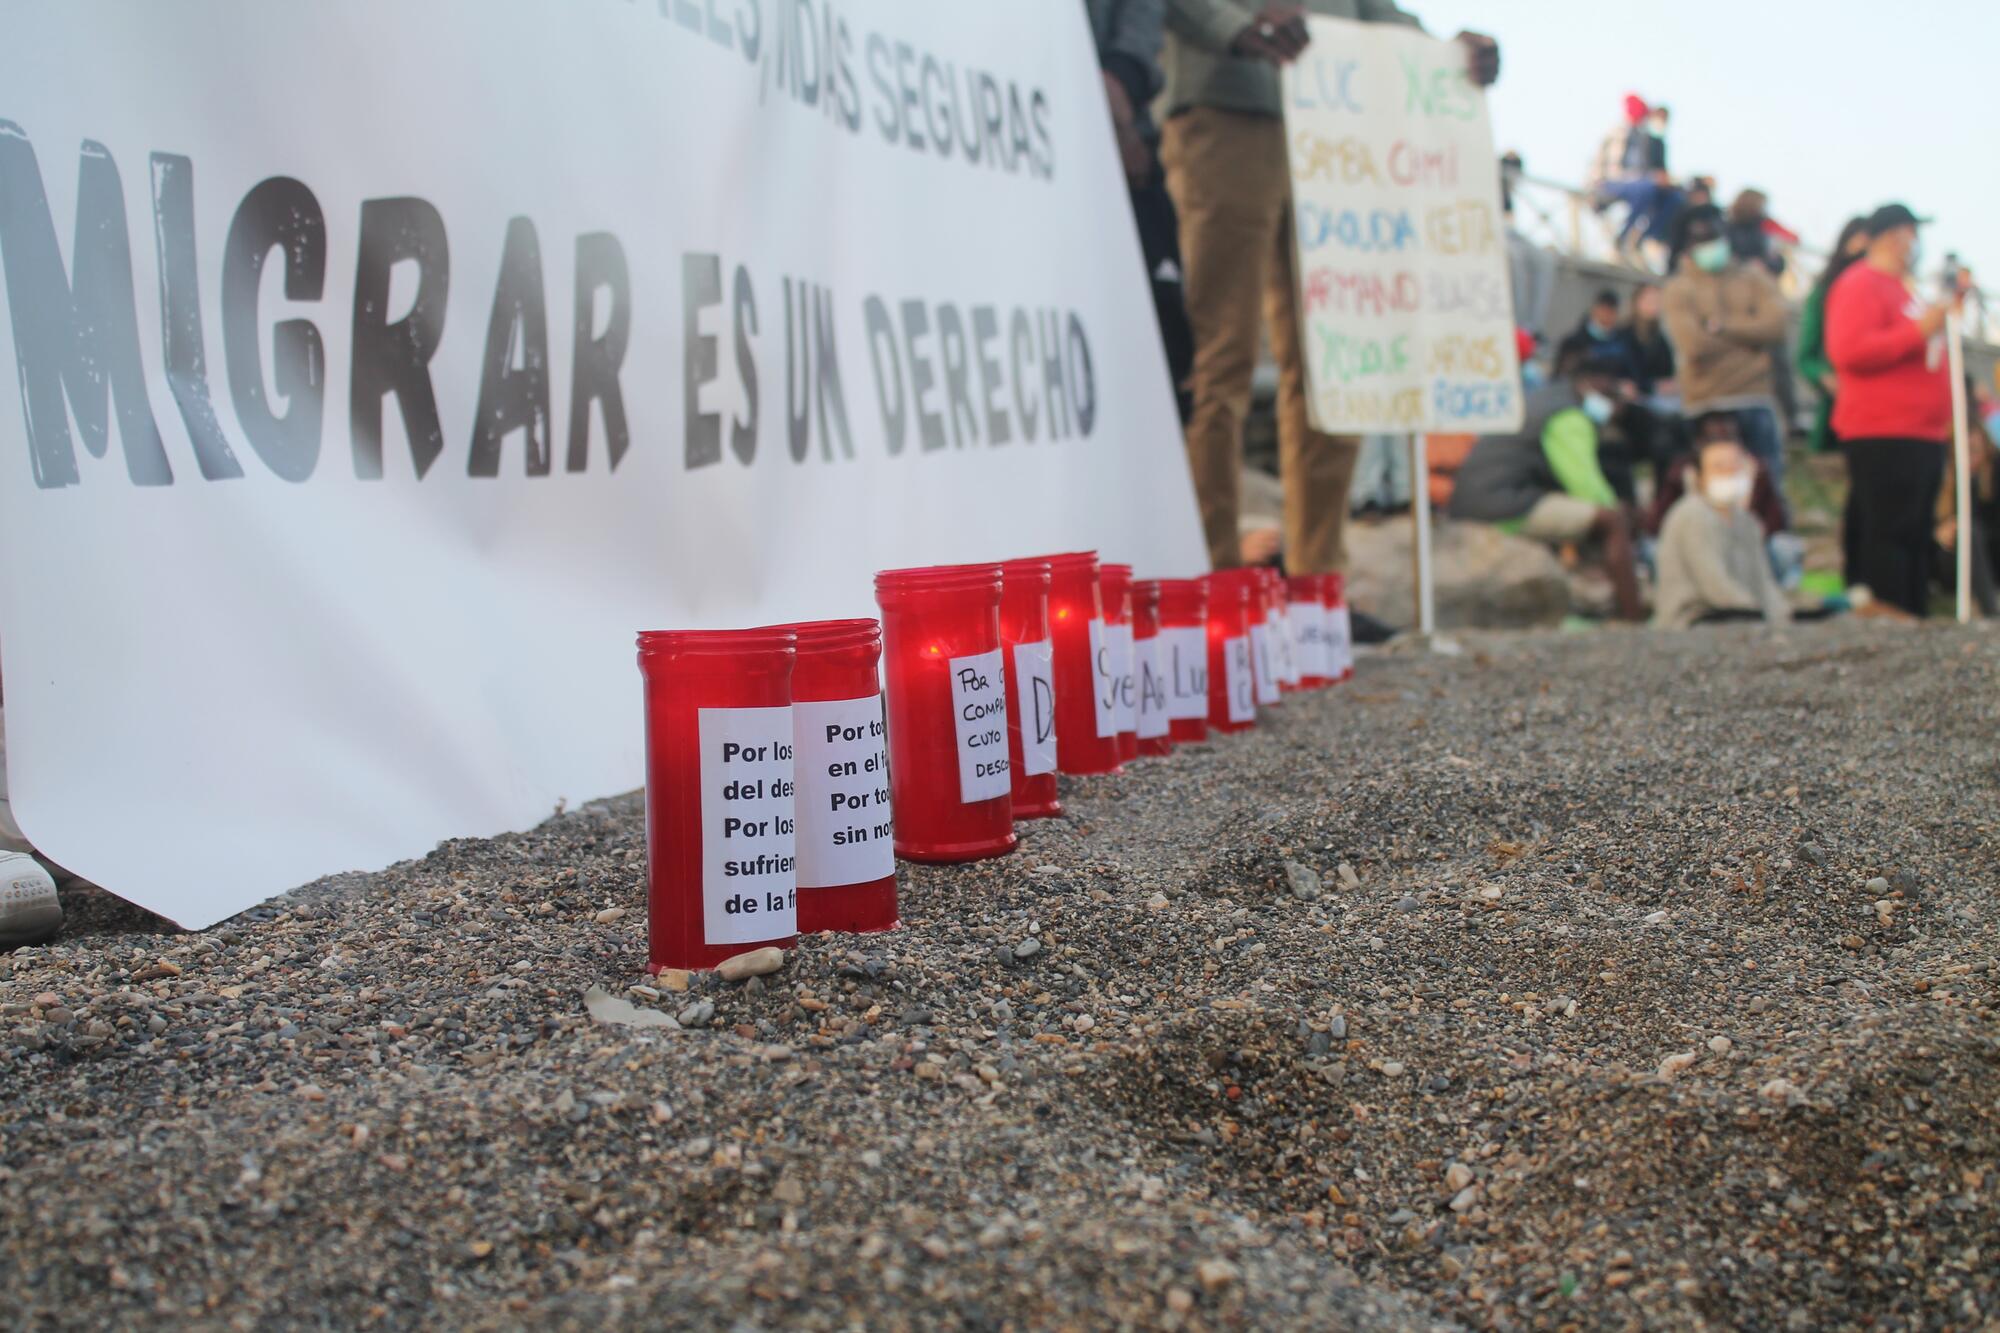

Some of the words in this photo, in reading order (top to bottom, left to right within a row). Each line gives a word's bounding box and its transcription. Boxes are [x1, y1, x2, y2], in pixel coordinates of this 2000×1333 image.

[1292, 58, 1362, 114] LUC
[865, 30, 1055, 182] SEGURAS
[1298, 199, 1419, 253] DAOUDA
[0, 118, 632, 489] MIGRAR
[682, 252, 760, 471] ES
[782, 275, 856, 465] UN
[862, 292, 1097, 458] DERECHO
[826, 724, 865, 744] Por
[967, 730, 1001, 748] CUYO
[723, 742, 768, 764] Por
[773, 741, 793, 762] los
[828, 761, 858, 778] en
[864, 752, 879, 773] el
[723, 779, 764, 801] del
[770, 778, 795, 799] des
[831, 792, 870, 812] Por
[724, 817, 769, 839] Por
[775, 815, 795, 836] los
[832, 825, 868, 846] sin
[724, 894, 759, 915] de
[766, 892, 785, 913] la
